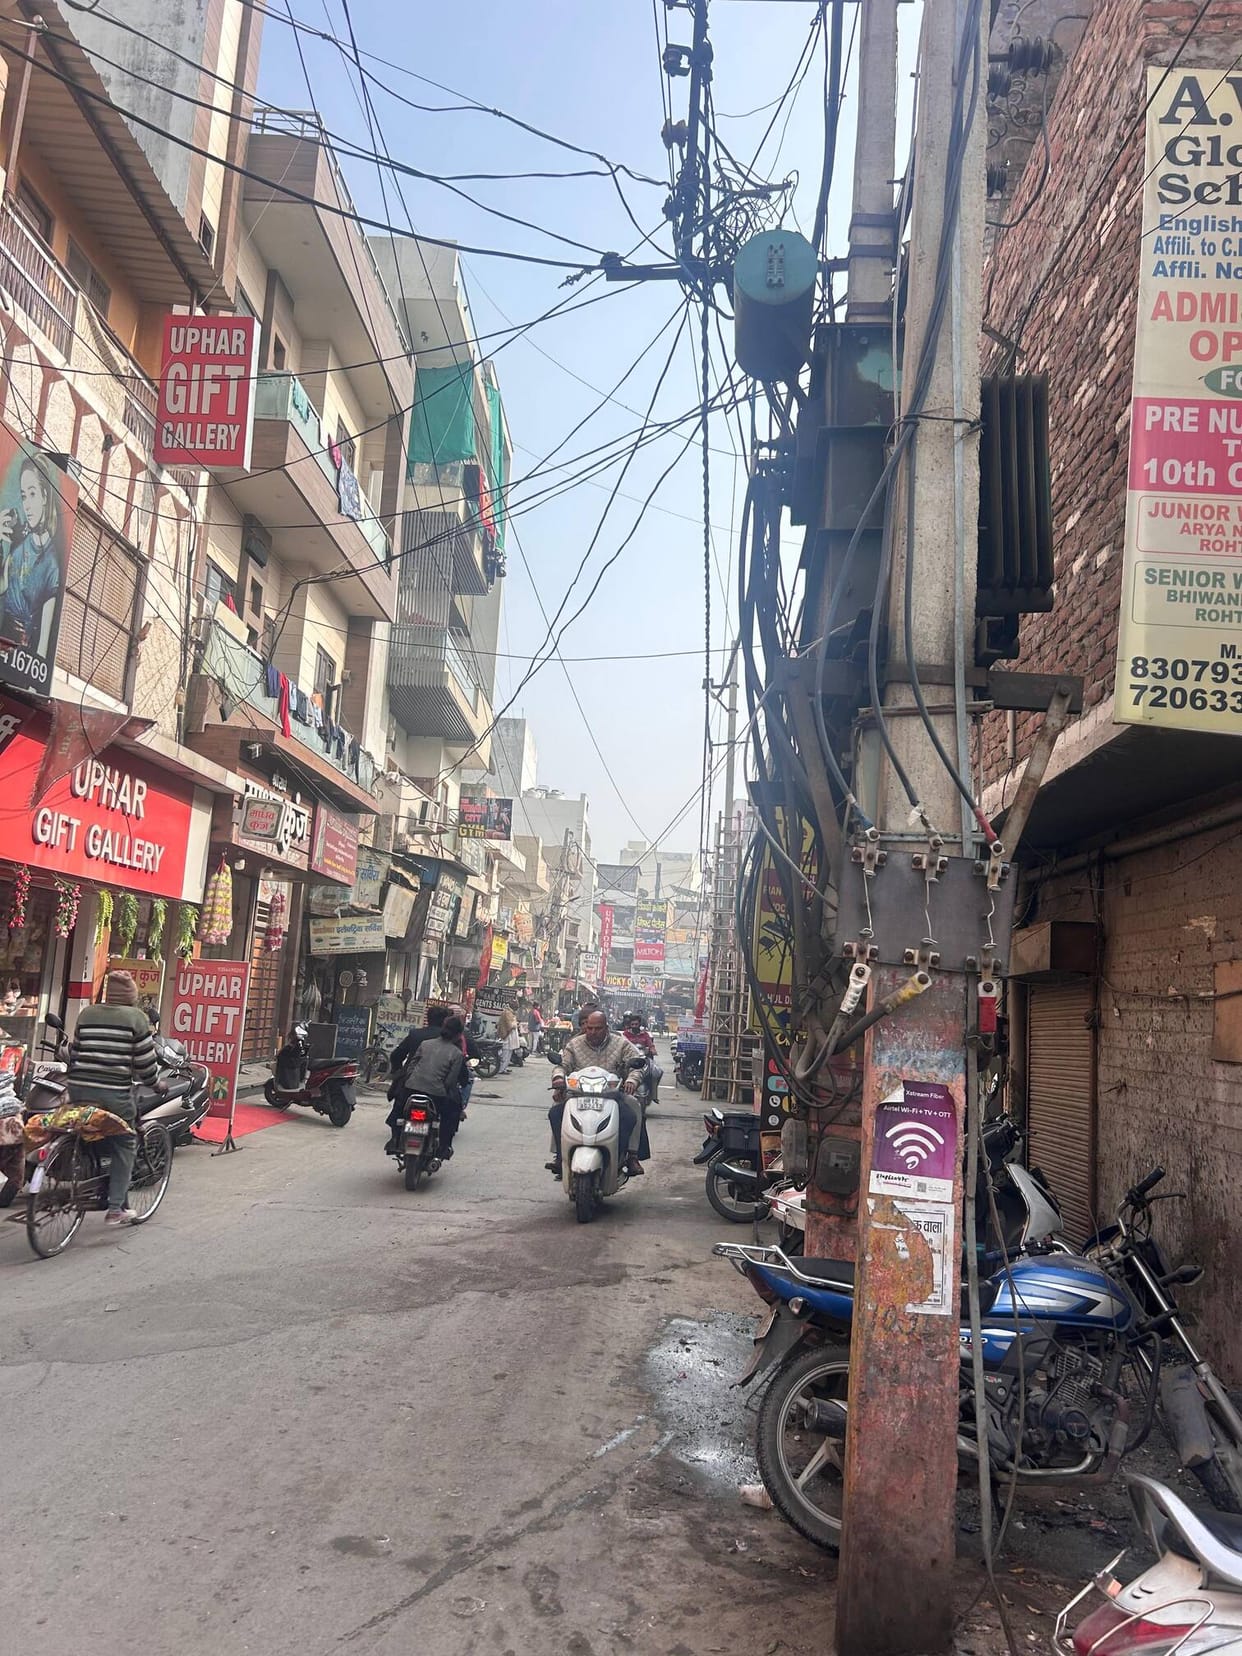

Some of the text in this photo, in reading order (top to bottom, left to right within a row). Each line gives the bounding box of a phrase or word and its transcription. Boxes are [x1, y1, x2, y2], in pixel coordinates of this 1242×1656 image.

[1159, 213, 1242, 236] English
[1153, 235, 1242, 257] Affili. to C.
[1152, 260, 1207, 278] Affli.
[1150, 290, 1242, 324] ADMI
[170, 327, 246, 356] UPHAR
[1189, 329, 1242, 362] OP
[165, 362, 245, 417] GIFT
[1145, 405, 1242, 435] PRE NU
[161, 421, 240, 451] GALLERY
[1222, 438, 1242, 457] T
[1143, 457, 1216, 488] 10th
[1147, 502, 1231, 521] JUNIOR
[1180, 522, 1227, 537] ARYA
[1199, 538, 1242, 553] ROH
[1144, 567, 1227, 589] SENIOR
[1129, 684, 1242, 714] 720633
[71, 758, 148, 820] UPHAR
[33, 807, 165, 875] GIFT GALLERY
[178, 972, 242, 999] UPHAR
[173, 1002, 240, 1036] GIFT
[183, 1039, 235, 1064] ALLERY
[905, 1089, 929, 1098] Xstream
[883, 1104, 900, 1112] Airtel
[900, 1106, 918, 1114] Wi-Fi
